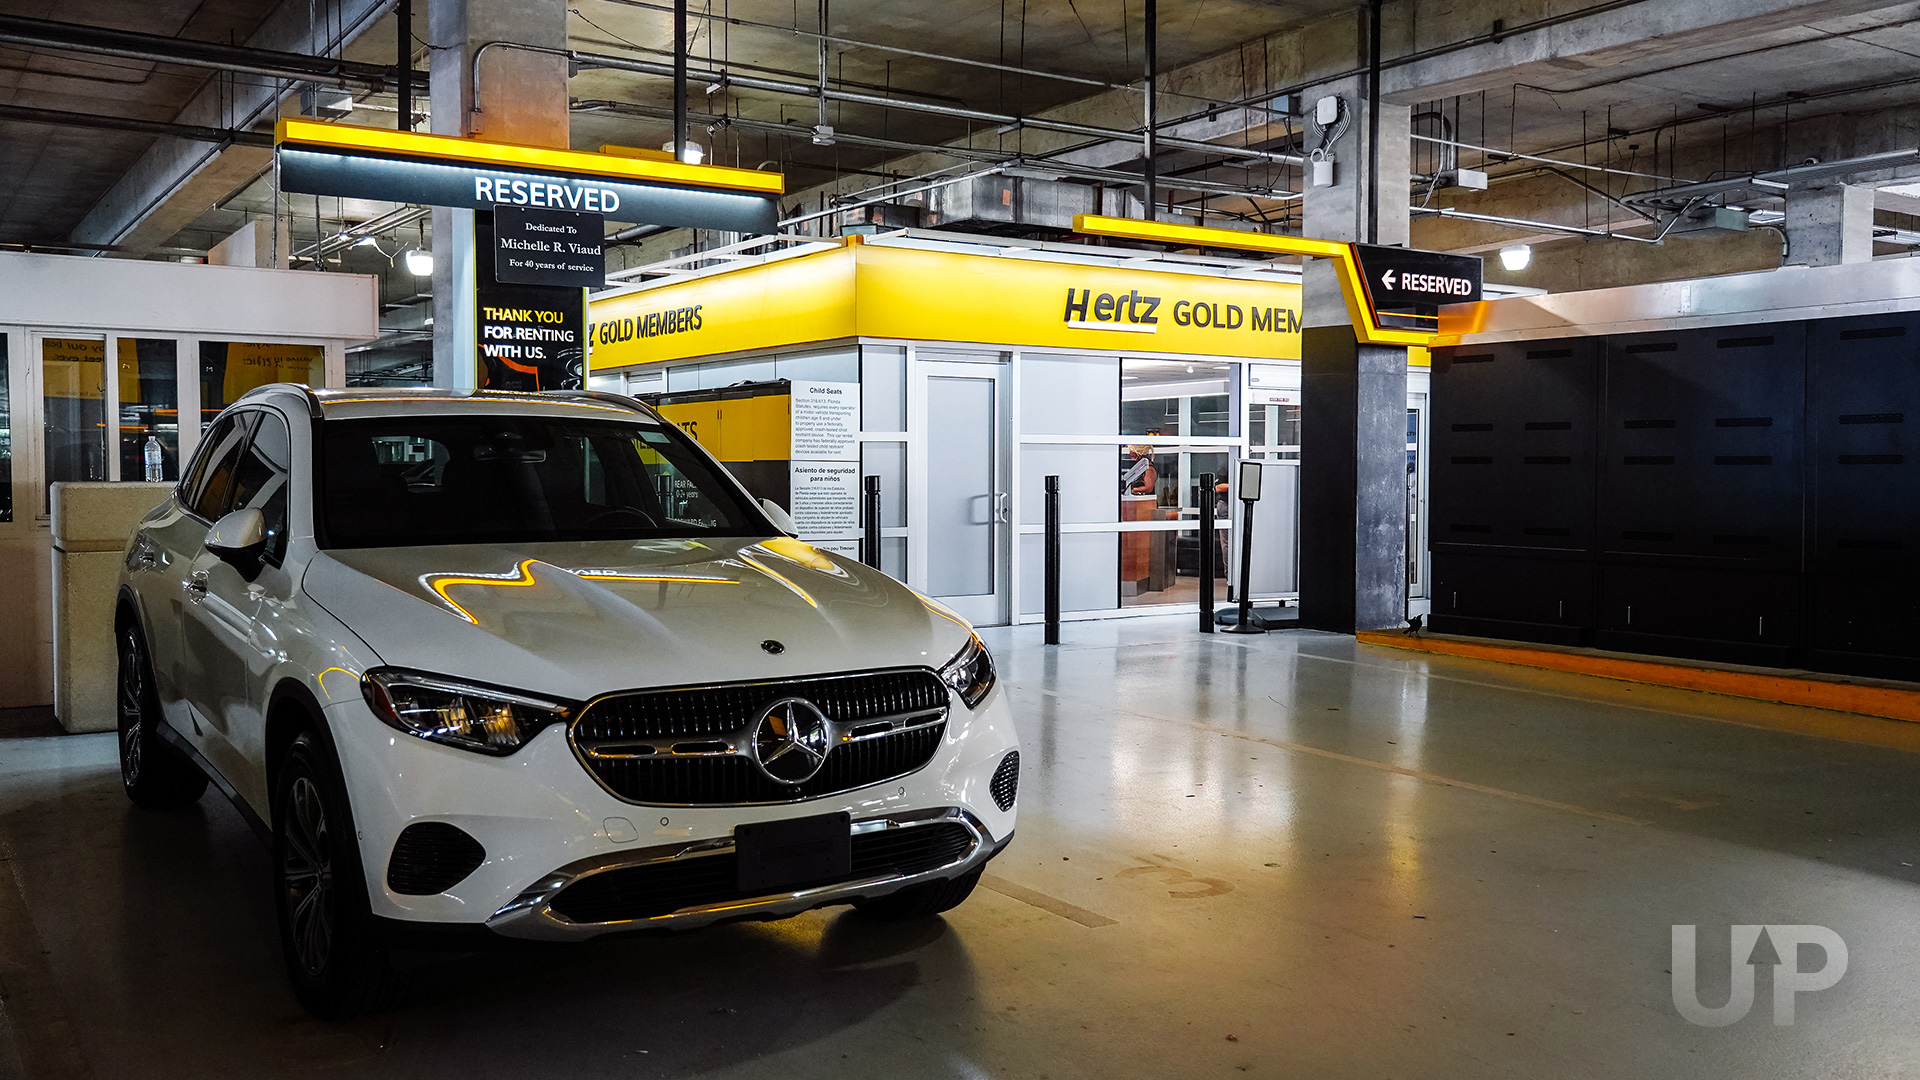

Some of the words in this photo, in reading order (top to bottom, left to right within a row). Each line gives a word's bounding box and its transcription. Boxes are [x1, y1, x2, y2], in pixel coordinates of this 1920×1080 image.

[475, 176, 620, 213] RESERVED
[525, 222, 565, 233] Dedicated
[567, 226, 577, 234] To
[501, 238, 550, 252] Michelle
[553, 242, 566, 253] R.
[568, 243, 601, 256] Viaud
[509, 259, 523, 267] For
[525, 260, 534, 268] 40
[568, 264, 594, 272] service
[1401, 272, 1472, 296] RESERVED
[483, 307, 533, 322] THANK
[534, 310, 564, 324] YOU
[1063, 288, 1161, 324] Hertz
[1173, 300, 1243, 330] GOLD
[1251, 306, 1303, 334] MEM
[600, 318, 634, 345] GOLD
[636, 304, 702, 340] MEMBERS
[484, 325, 513, 339] FOR
[515, 327, 574, 342] RENTING
[483, 344, 521, 358] WITH
[525, 346, 547, 359] US.
